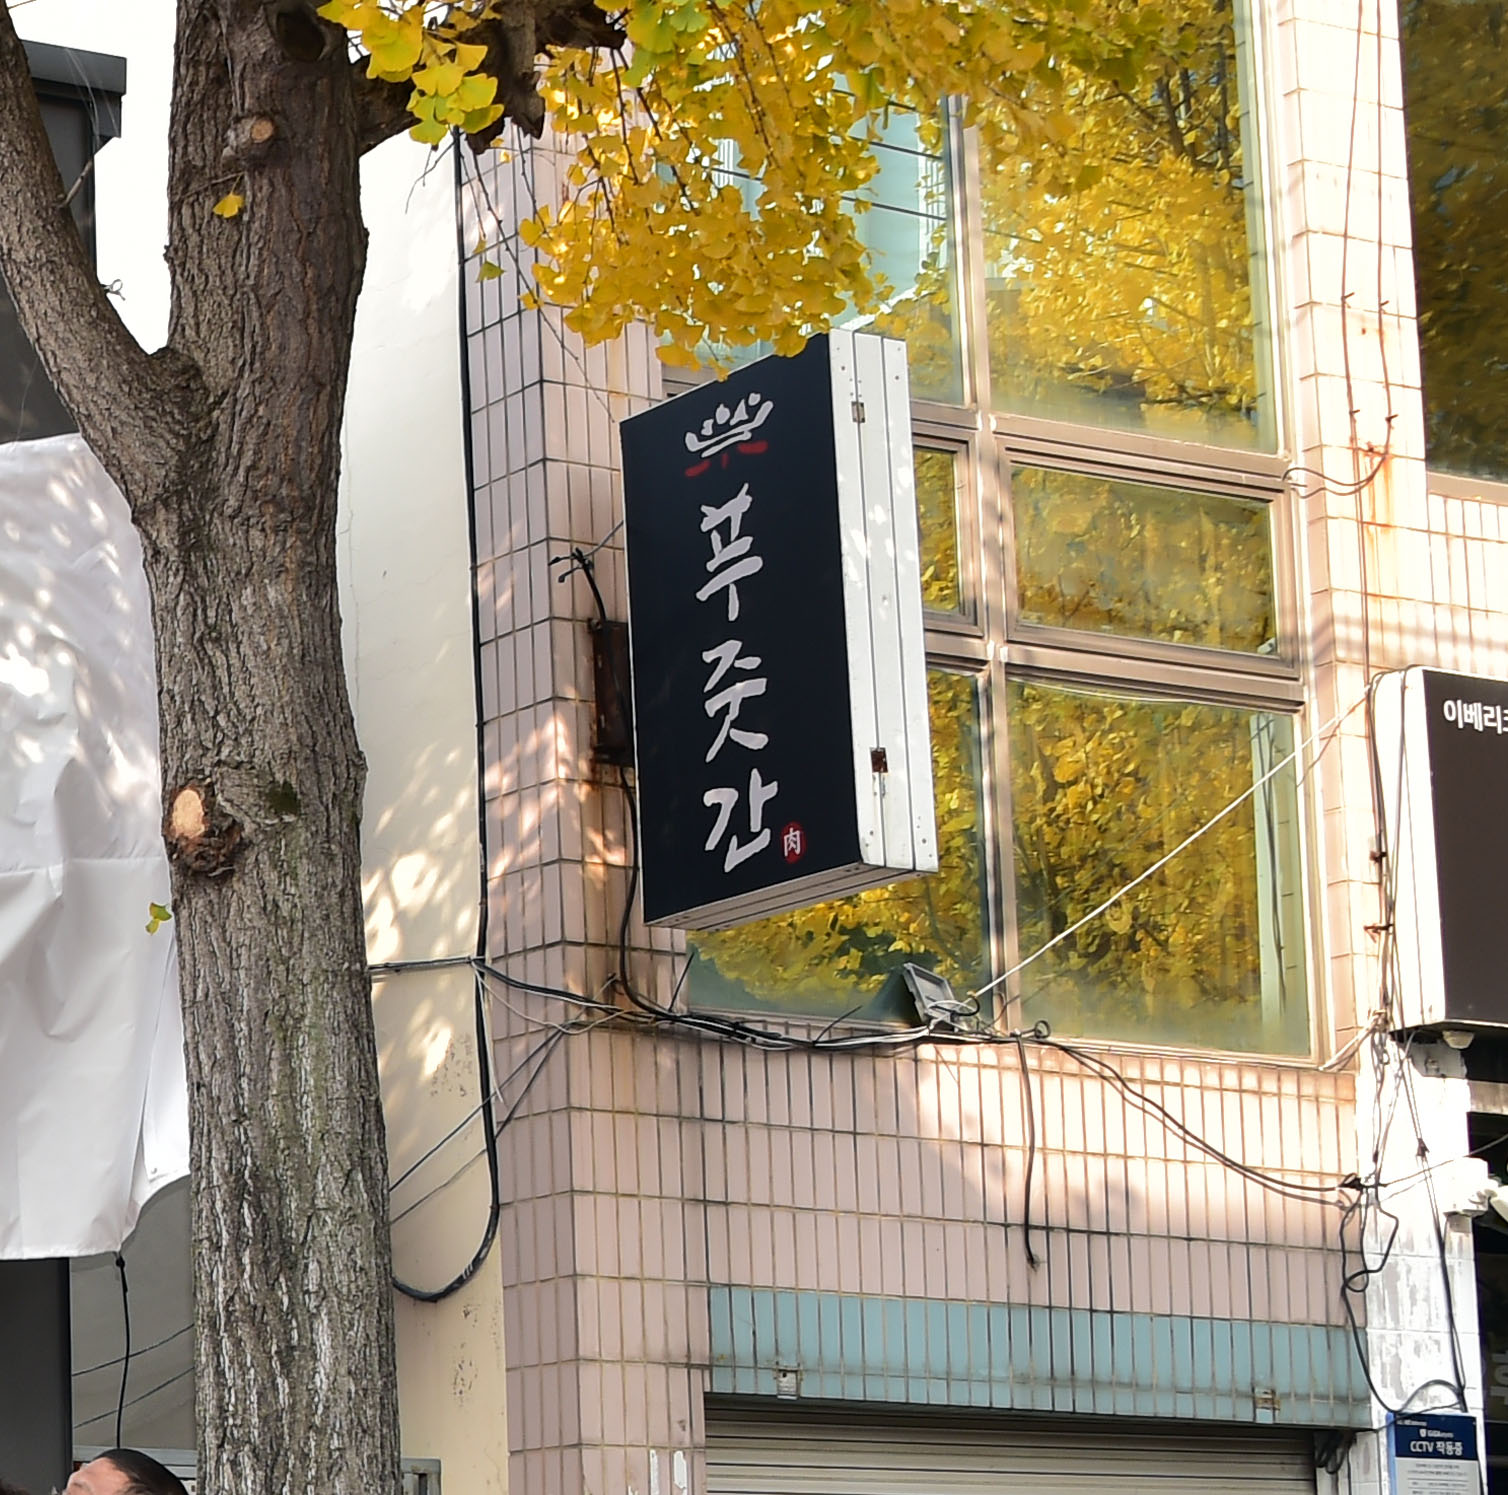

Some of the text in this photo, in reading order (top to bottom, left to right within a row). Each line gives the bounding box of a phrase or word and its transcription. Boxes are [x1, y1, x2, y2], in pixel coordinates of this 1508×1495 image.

[1443, 698, 1508, 735] 이베리
[783, 828, 802, 858] 肉
[1410, 1440, 1434, 1453] CCTV
